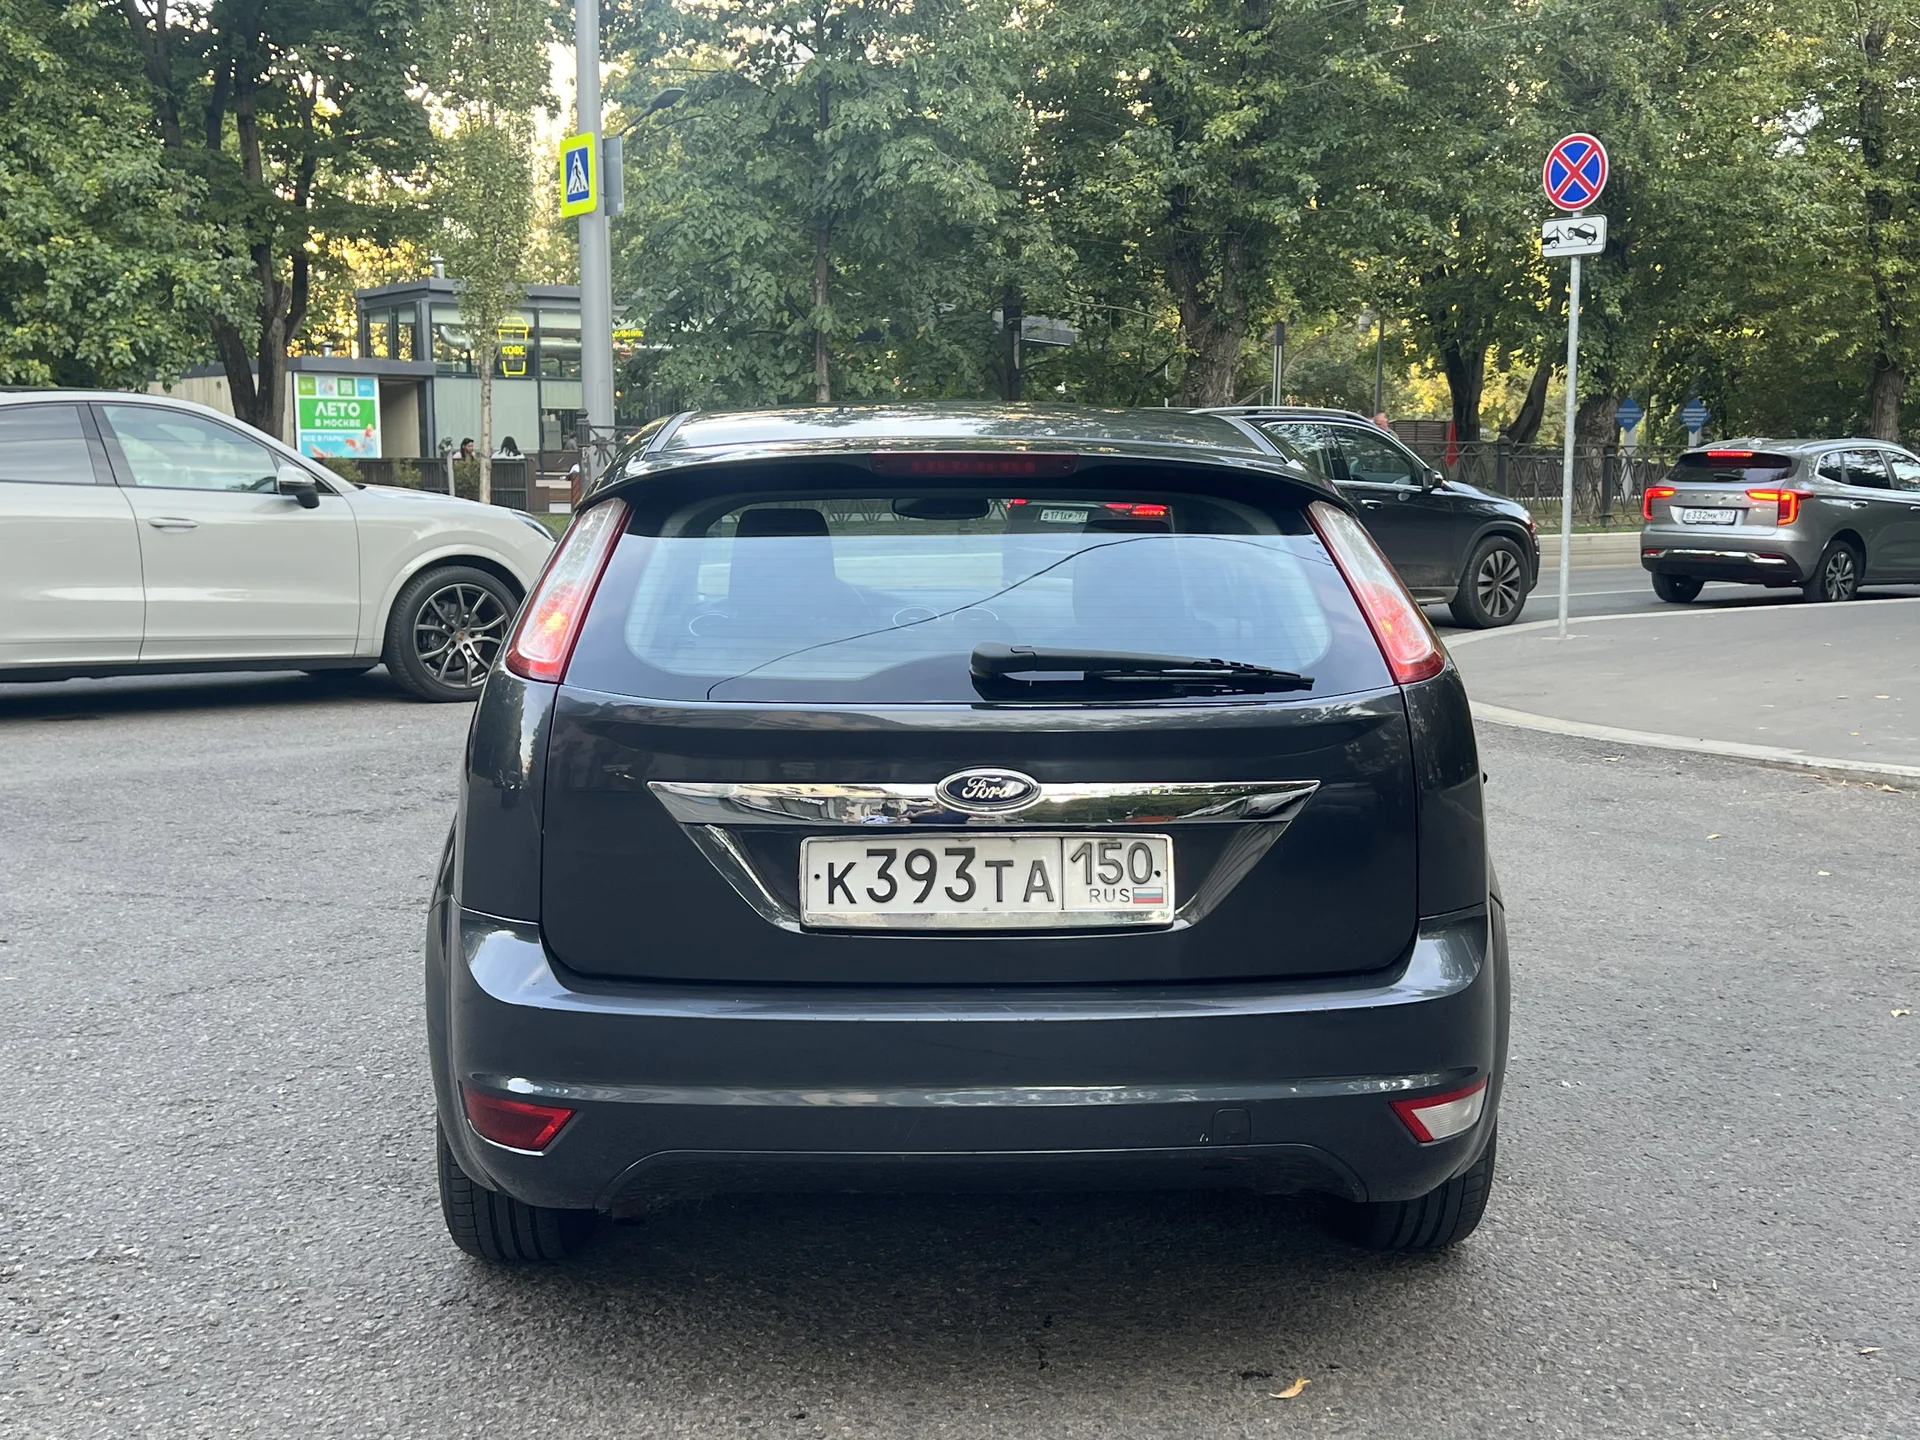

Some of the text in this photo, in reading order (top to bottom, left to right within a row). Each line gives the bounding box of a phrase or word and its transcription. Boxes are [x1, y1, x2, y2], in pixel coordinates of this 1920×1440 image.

[502, 345, 526, 356] КОФЕ
[315, 401, 361, 417] ЛЕТО
[315, 418, 361, 427] В МОСКВЕ
[962, 776, 1015, 799] Ford
[828, 842, 1153, 904] К393ТА 150
[1089, 888, 1130, 903] RUS
